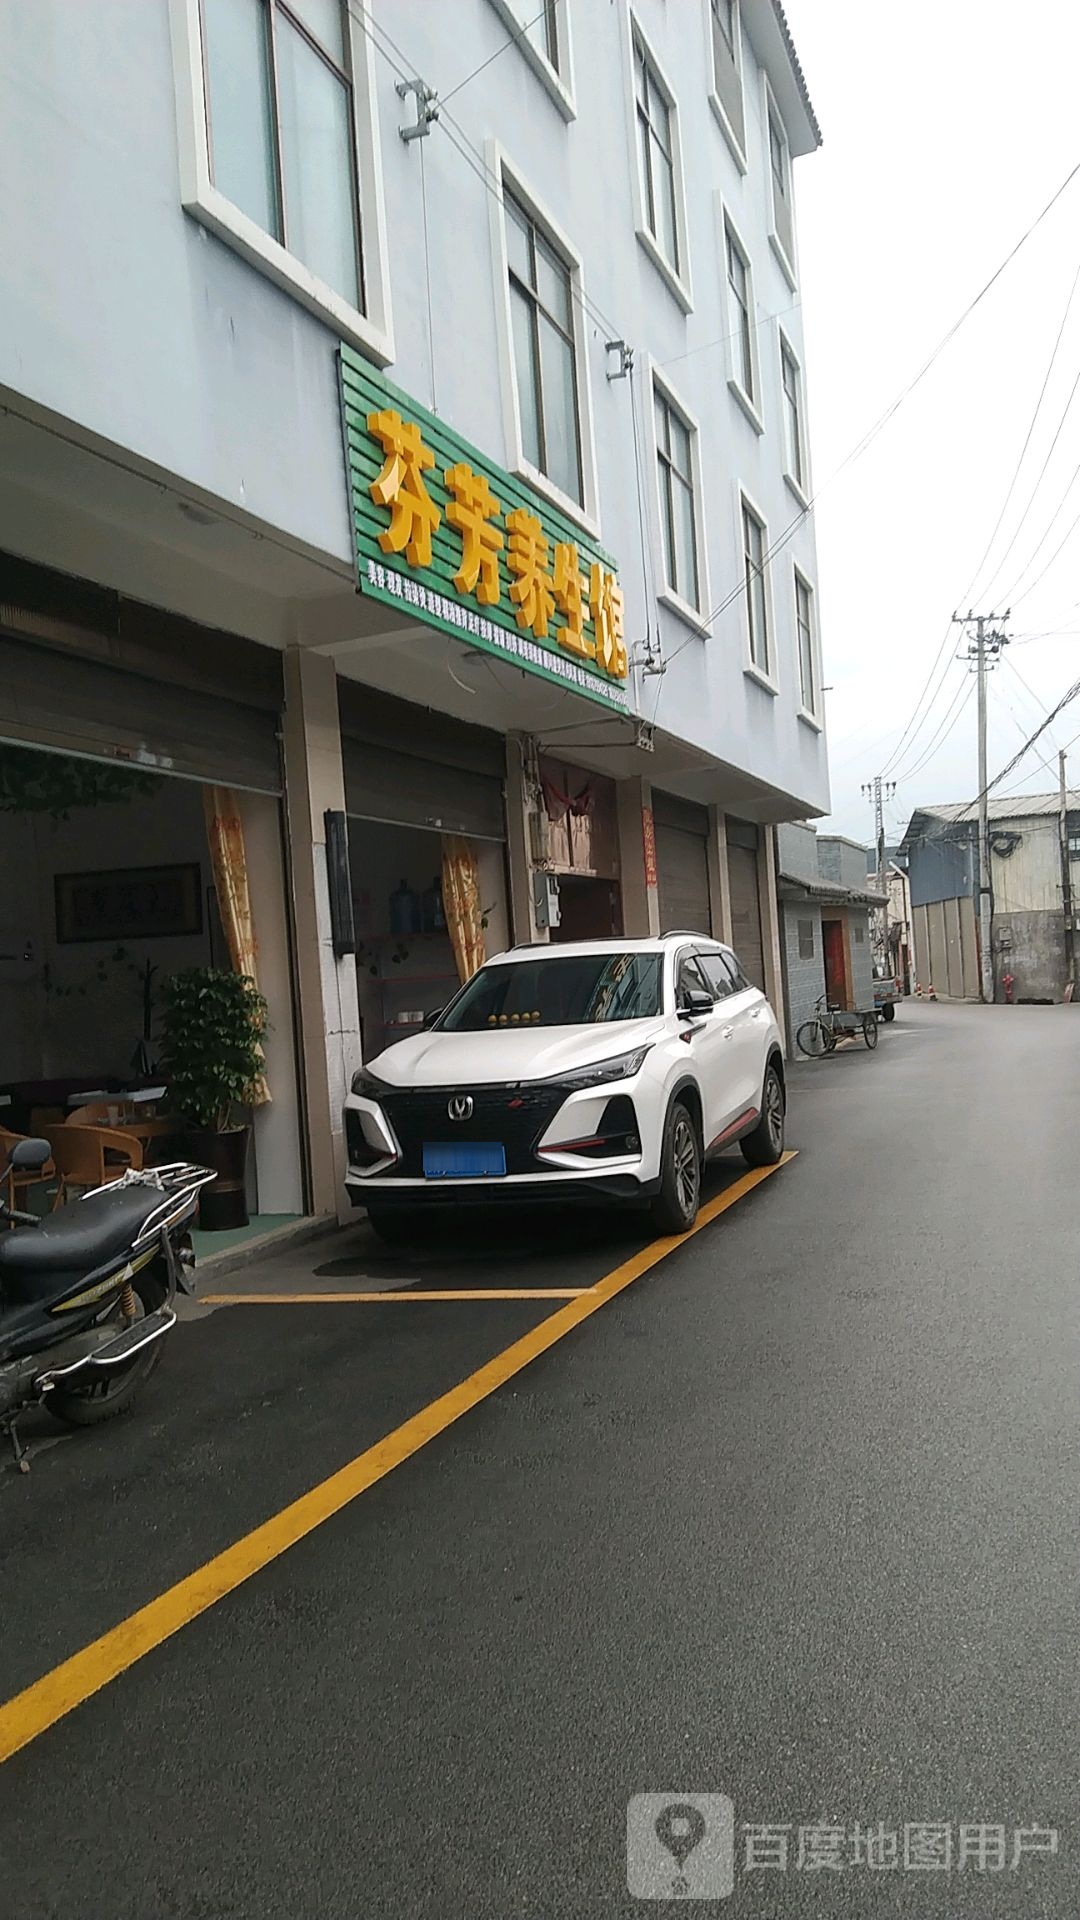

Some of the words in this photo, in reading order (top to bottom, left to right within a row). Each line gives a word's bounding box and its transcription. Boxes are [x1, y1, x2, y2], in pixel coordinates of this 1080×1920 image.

[368, 409, 626, 678] 芬芳养生馆
